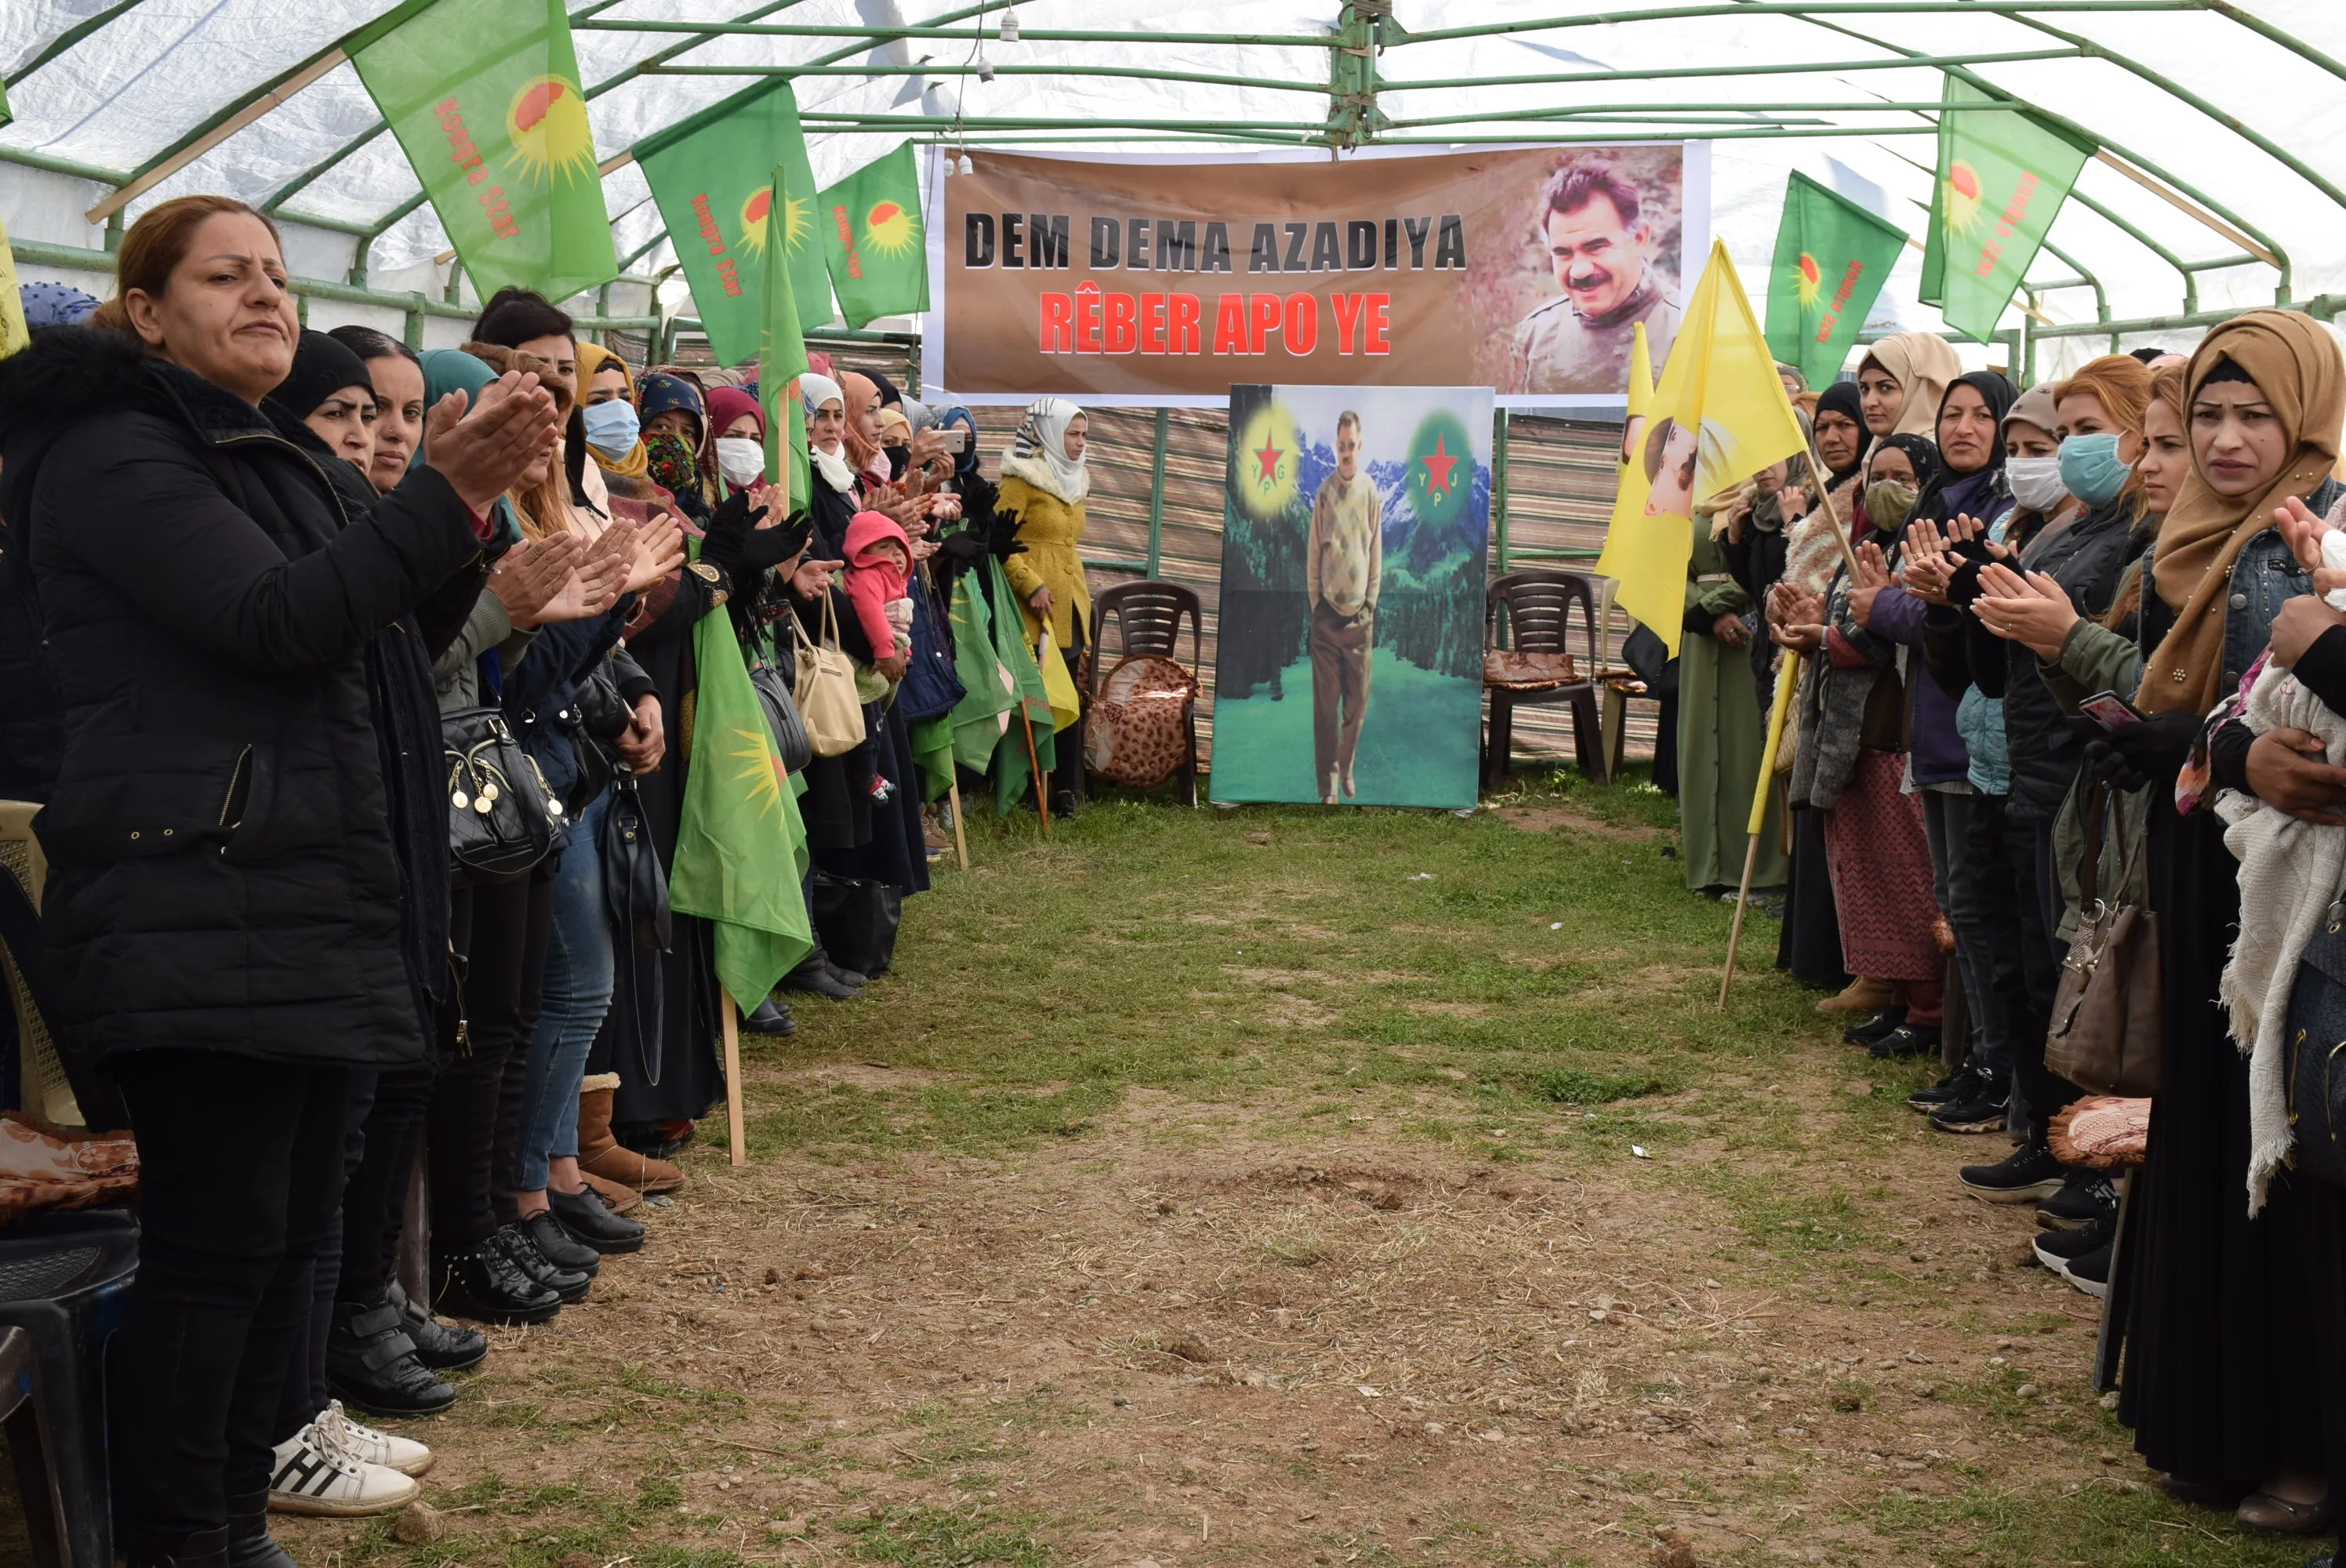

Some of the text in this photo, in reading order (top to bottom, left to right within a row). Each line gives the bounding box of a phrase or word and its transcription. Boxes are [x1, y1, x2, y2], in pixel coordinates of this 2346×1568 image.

[433, 96, 520, 240] Kongra Star
[690, 192, 743, 298] Kongra Star
[847, 252, 863, 280] Star
[964, 211, 1469, 274] DEM DEMA AZADIYA
[1039, 279, 1392, 358] RÊBER APO YE
